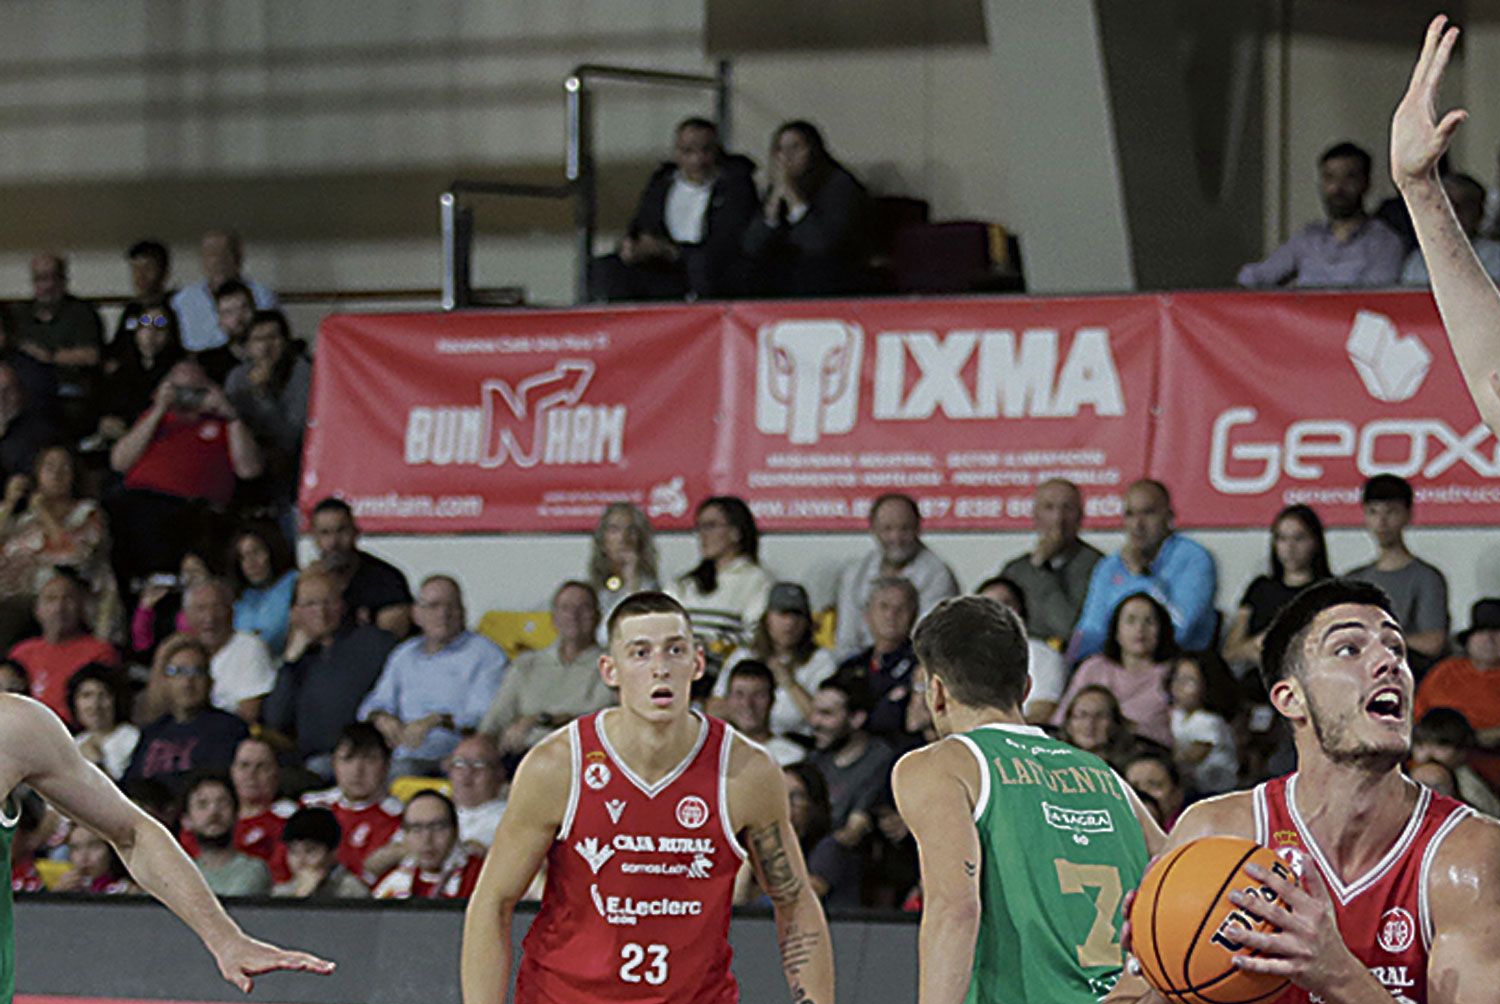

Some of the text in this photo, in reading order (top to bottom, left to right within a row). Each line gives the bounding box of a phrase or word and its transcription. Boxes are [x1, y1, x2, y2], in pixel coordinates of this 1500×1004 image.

[872, 327, 1126, 420] IXMA
[606, 896, 702, 915] E.Leclerc
[1055, 858, 1122, 967] 7
[619, 943, 670, 985] 23
[1369, 965, 1415, 987] RAL
